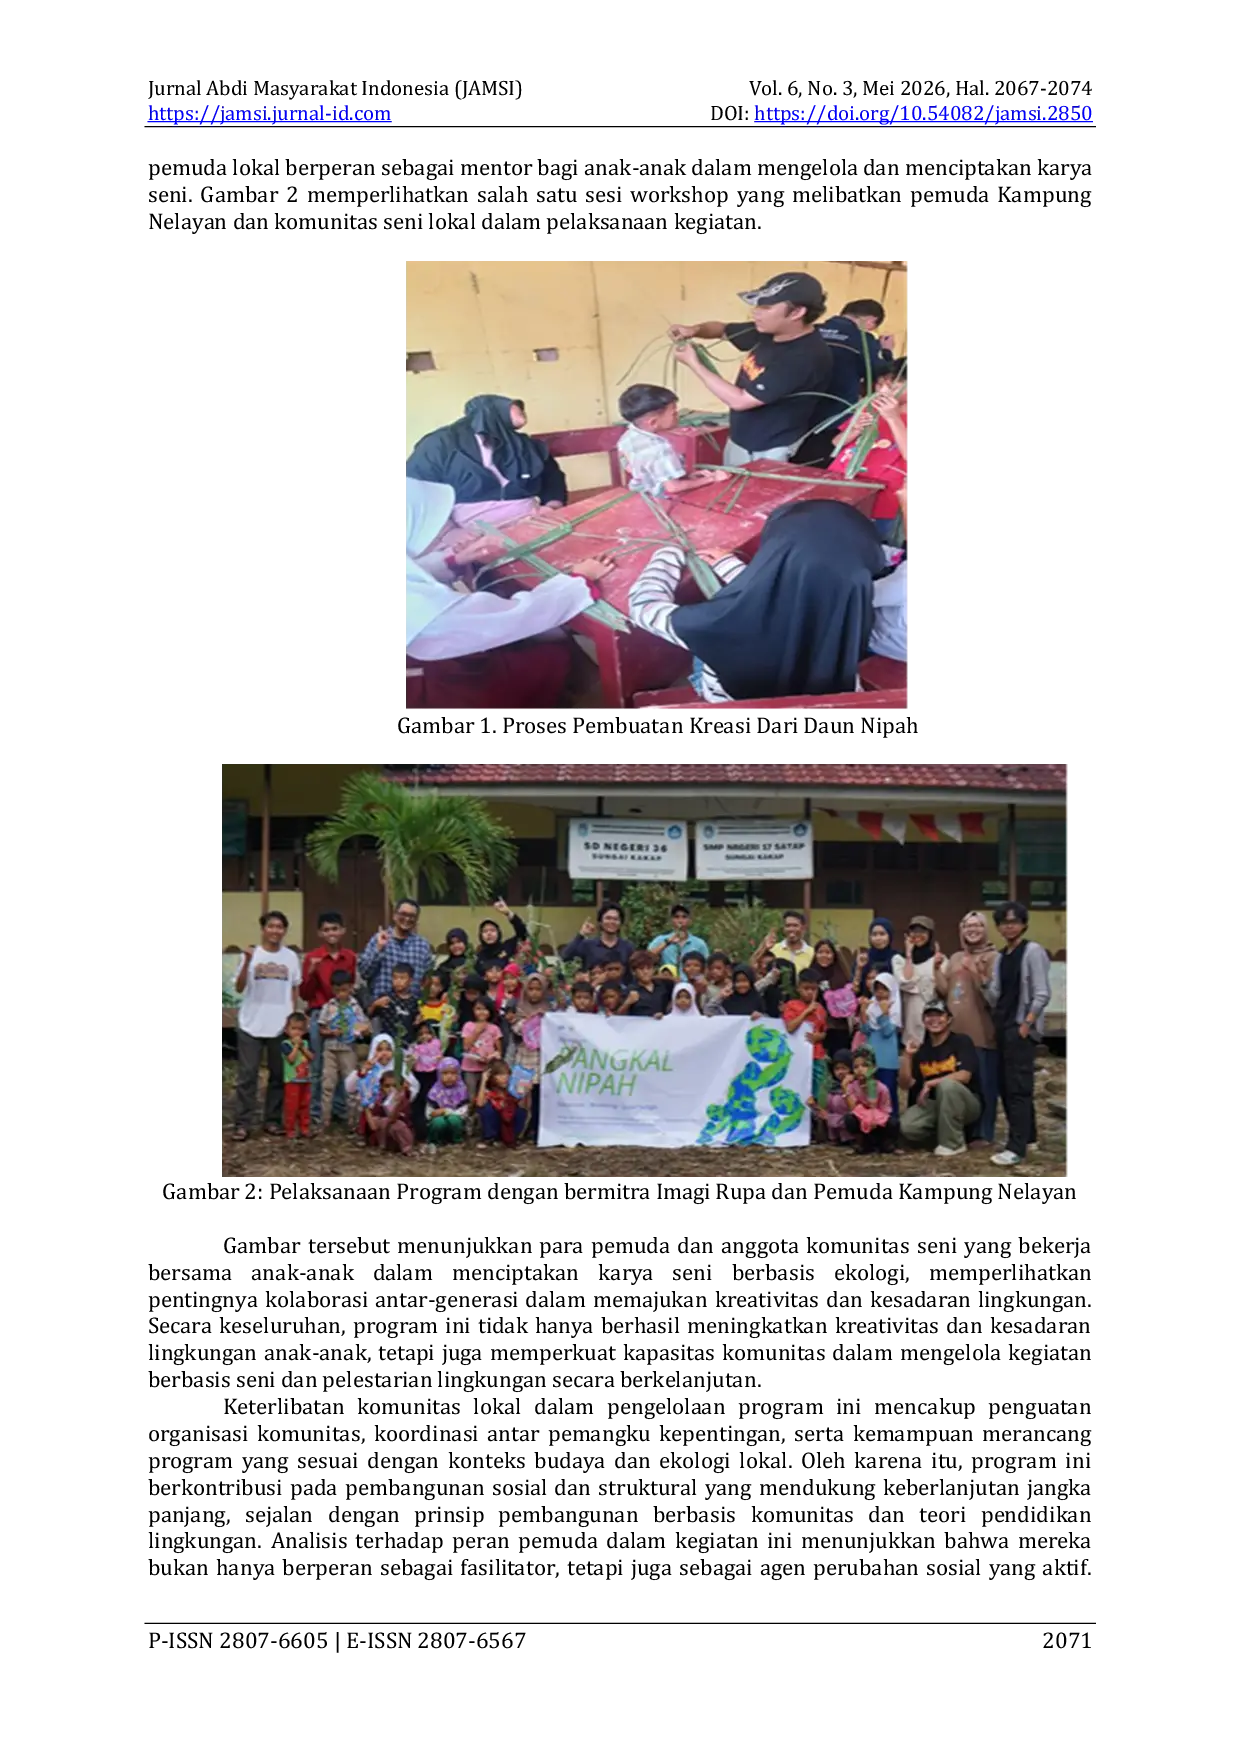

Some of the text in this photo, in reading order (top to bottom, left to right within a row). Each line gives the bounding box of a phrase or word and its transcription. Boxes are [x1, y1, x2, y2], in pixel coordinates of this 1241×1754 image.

[147, 79, 523, 101] Jurnal Abdi Masyarakat Indonesia (JAMSI)
[748, 79, 1093, 99] Vol. 6, No. 3, Mei 2026, Hal. 2067-2074
[146, 104, 392, 126] https://jamsi.jurnal-id.com
[710, 104, 1092, 126] DOI: https://doi.org/10.54082/jamsi.2850
[148, 158, 1093, 181] pemuda lokal berperan sebagai mentor bagi anak-anak dalam mengelola dan menciptakan karya
[148, 185, 1092, 208] seni. Gambar 2 memperlihatkan salah satu sesi workshop yang melibatkan pemuda Kampung
[148, 212, 762, 235] Nelayan dan komunitas seni lokal dalam pelaksanaan kegiatan.
[397, 716, 919, 739] Gambar 1. Proses Pembuatan Kreasi Dari Daun Nipah
[583, 842, 601, 851] SD
[603, 842, 650, 852] NEGERI
[556, 1072, 638, 1097] NIPAH
[162, 1182, 1077, 1205] Gambar 2: Pelaksanaan Program dengan bermitra Imagi Rupa dan Pemuda Kampung Nelayan
[223, 1236, 1092, 1259] Gambar tersebut menunjukkan para pemuda dan anggota komunitas seni yang bekerja
[148, 1290, 1092, 1313] pentingnya kolaborasi antar-generasi dalam memajukan kreativitas dan kesadaran lingkungan.
[148, 1343, 1092, 1366] lingkungan anak-anak, tetapi juga memperkuat kapasitas komunitas dalam mengelola kegiatan
[223, 1397, 1092, 1420] Keterlibatan komunitas lokal dalam pengelolaan program ini mencakup penguatan
[148, 1451, 1092, 1474] program yang sesuai dengan konteks budaya dan ekologi lokal. Oleh karena itu, program ini
[147, 1558, 1092, 1581] bukan hanya berperan sebagai fasilitator, tetapi juga sebagai agen perubahan sosial yang aktif.
[148, 1631, 527, 1650] P-ISSN 2807-6605 E-ISSN 2807-6567
[1042, 1631, 1092, 1650] 2071
